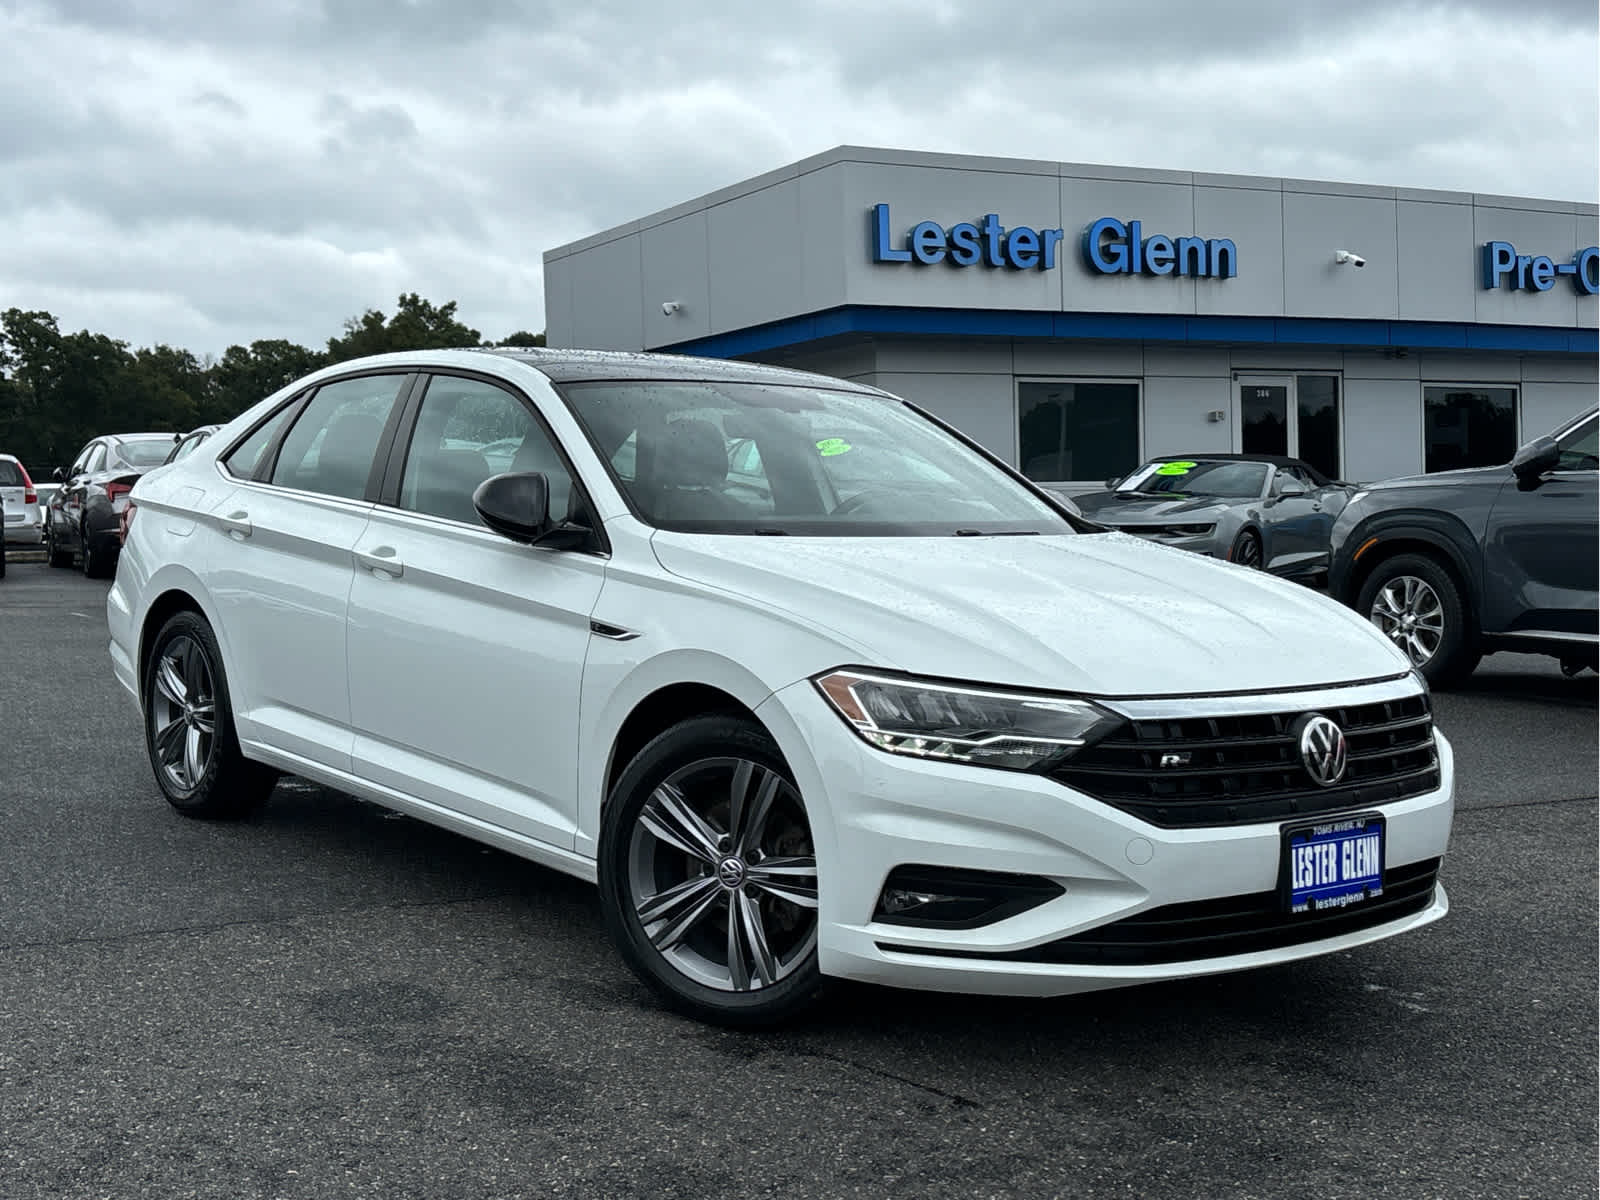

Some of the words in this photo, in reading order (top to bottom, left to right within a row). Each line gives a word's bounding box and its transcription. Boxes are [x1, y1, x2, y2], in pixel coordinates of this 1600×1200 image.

[872, 203, 1064, 271] Lester
[1085, 217, 1238, 279] Glenn
[1291, 842, 1338, 890] LESTER
[1342, 835, 1380, 881] GLENN
[1315, 892, 1365, 910] lesterglenn
